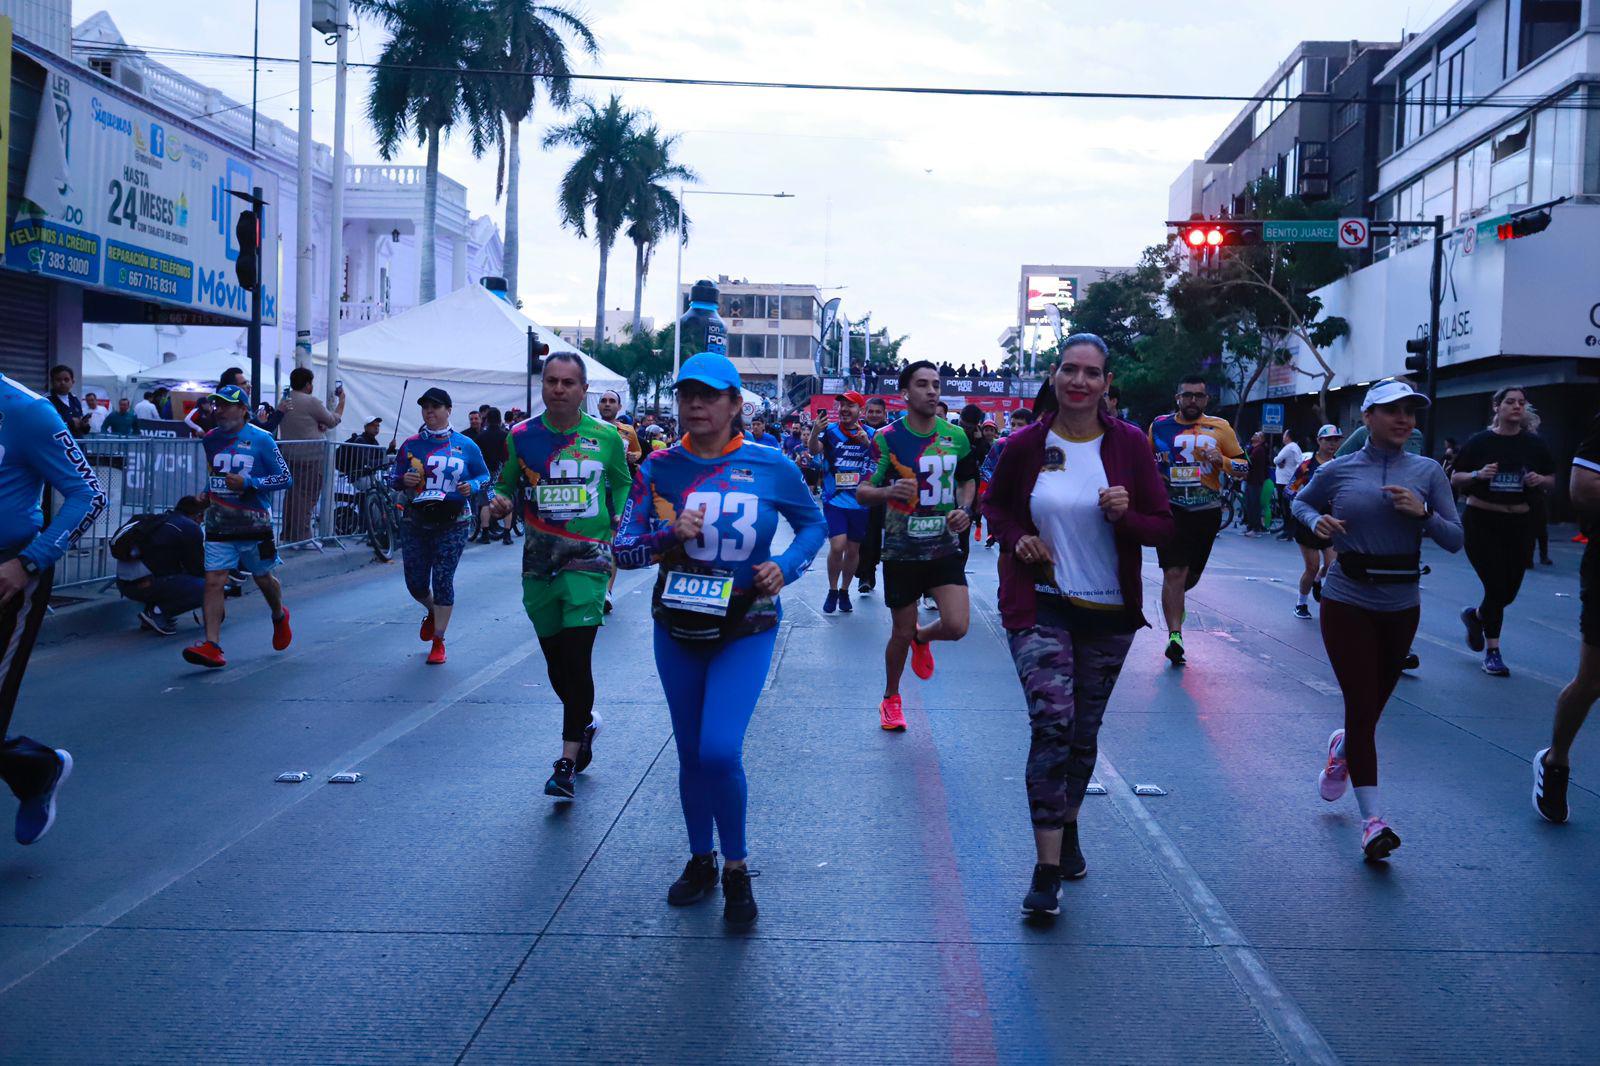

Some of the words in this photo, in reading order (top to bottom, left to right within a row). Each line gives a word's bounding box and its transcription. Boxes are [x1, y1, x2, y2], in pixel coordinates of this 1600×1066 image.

[123, 165, 149, 188] HASTA
[64, 205, 83, 225] DO
[108, 179, 137, 230] 24
[139, 190, 174, 226] MESES
[1266, 227, 1298, 239] BENITO
[1301, 227, 1334, 239] JUAREZ
[48, 251, 65, 270] 383
[67, 256, 90, 276] 3000
[150, 257, 159, 269] DE
[129, 270, 143, 287] 667
[145, 272, 158, 291] 715
[159, 275, 177, 295] 8314
[426, 455, 464, 493] 33
[919, 455, 957, 506] 33
[543, 487, 579, 503] 2201
[911, 518, 942, 531] 2042
[673, 576, 723, 598] 4015
[1068, 589, 1104, 597] Prevención
[1104, 588, 1116, 596] del
